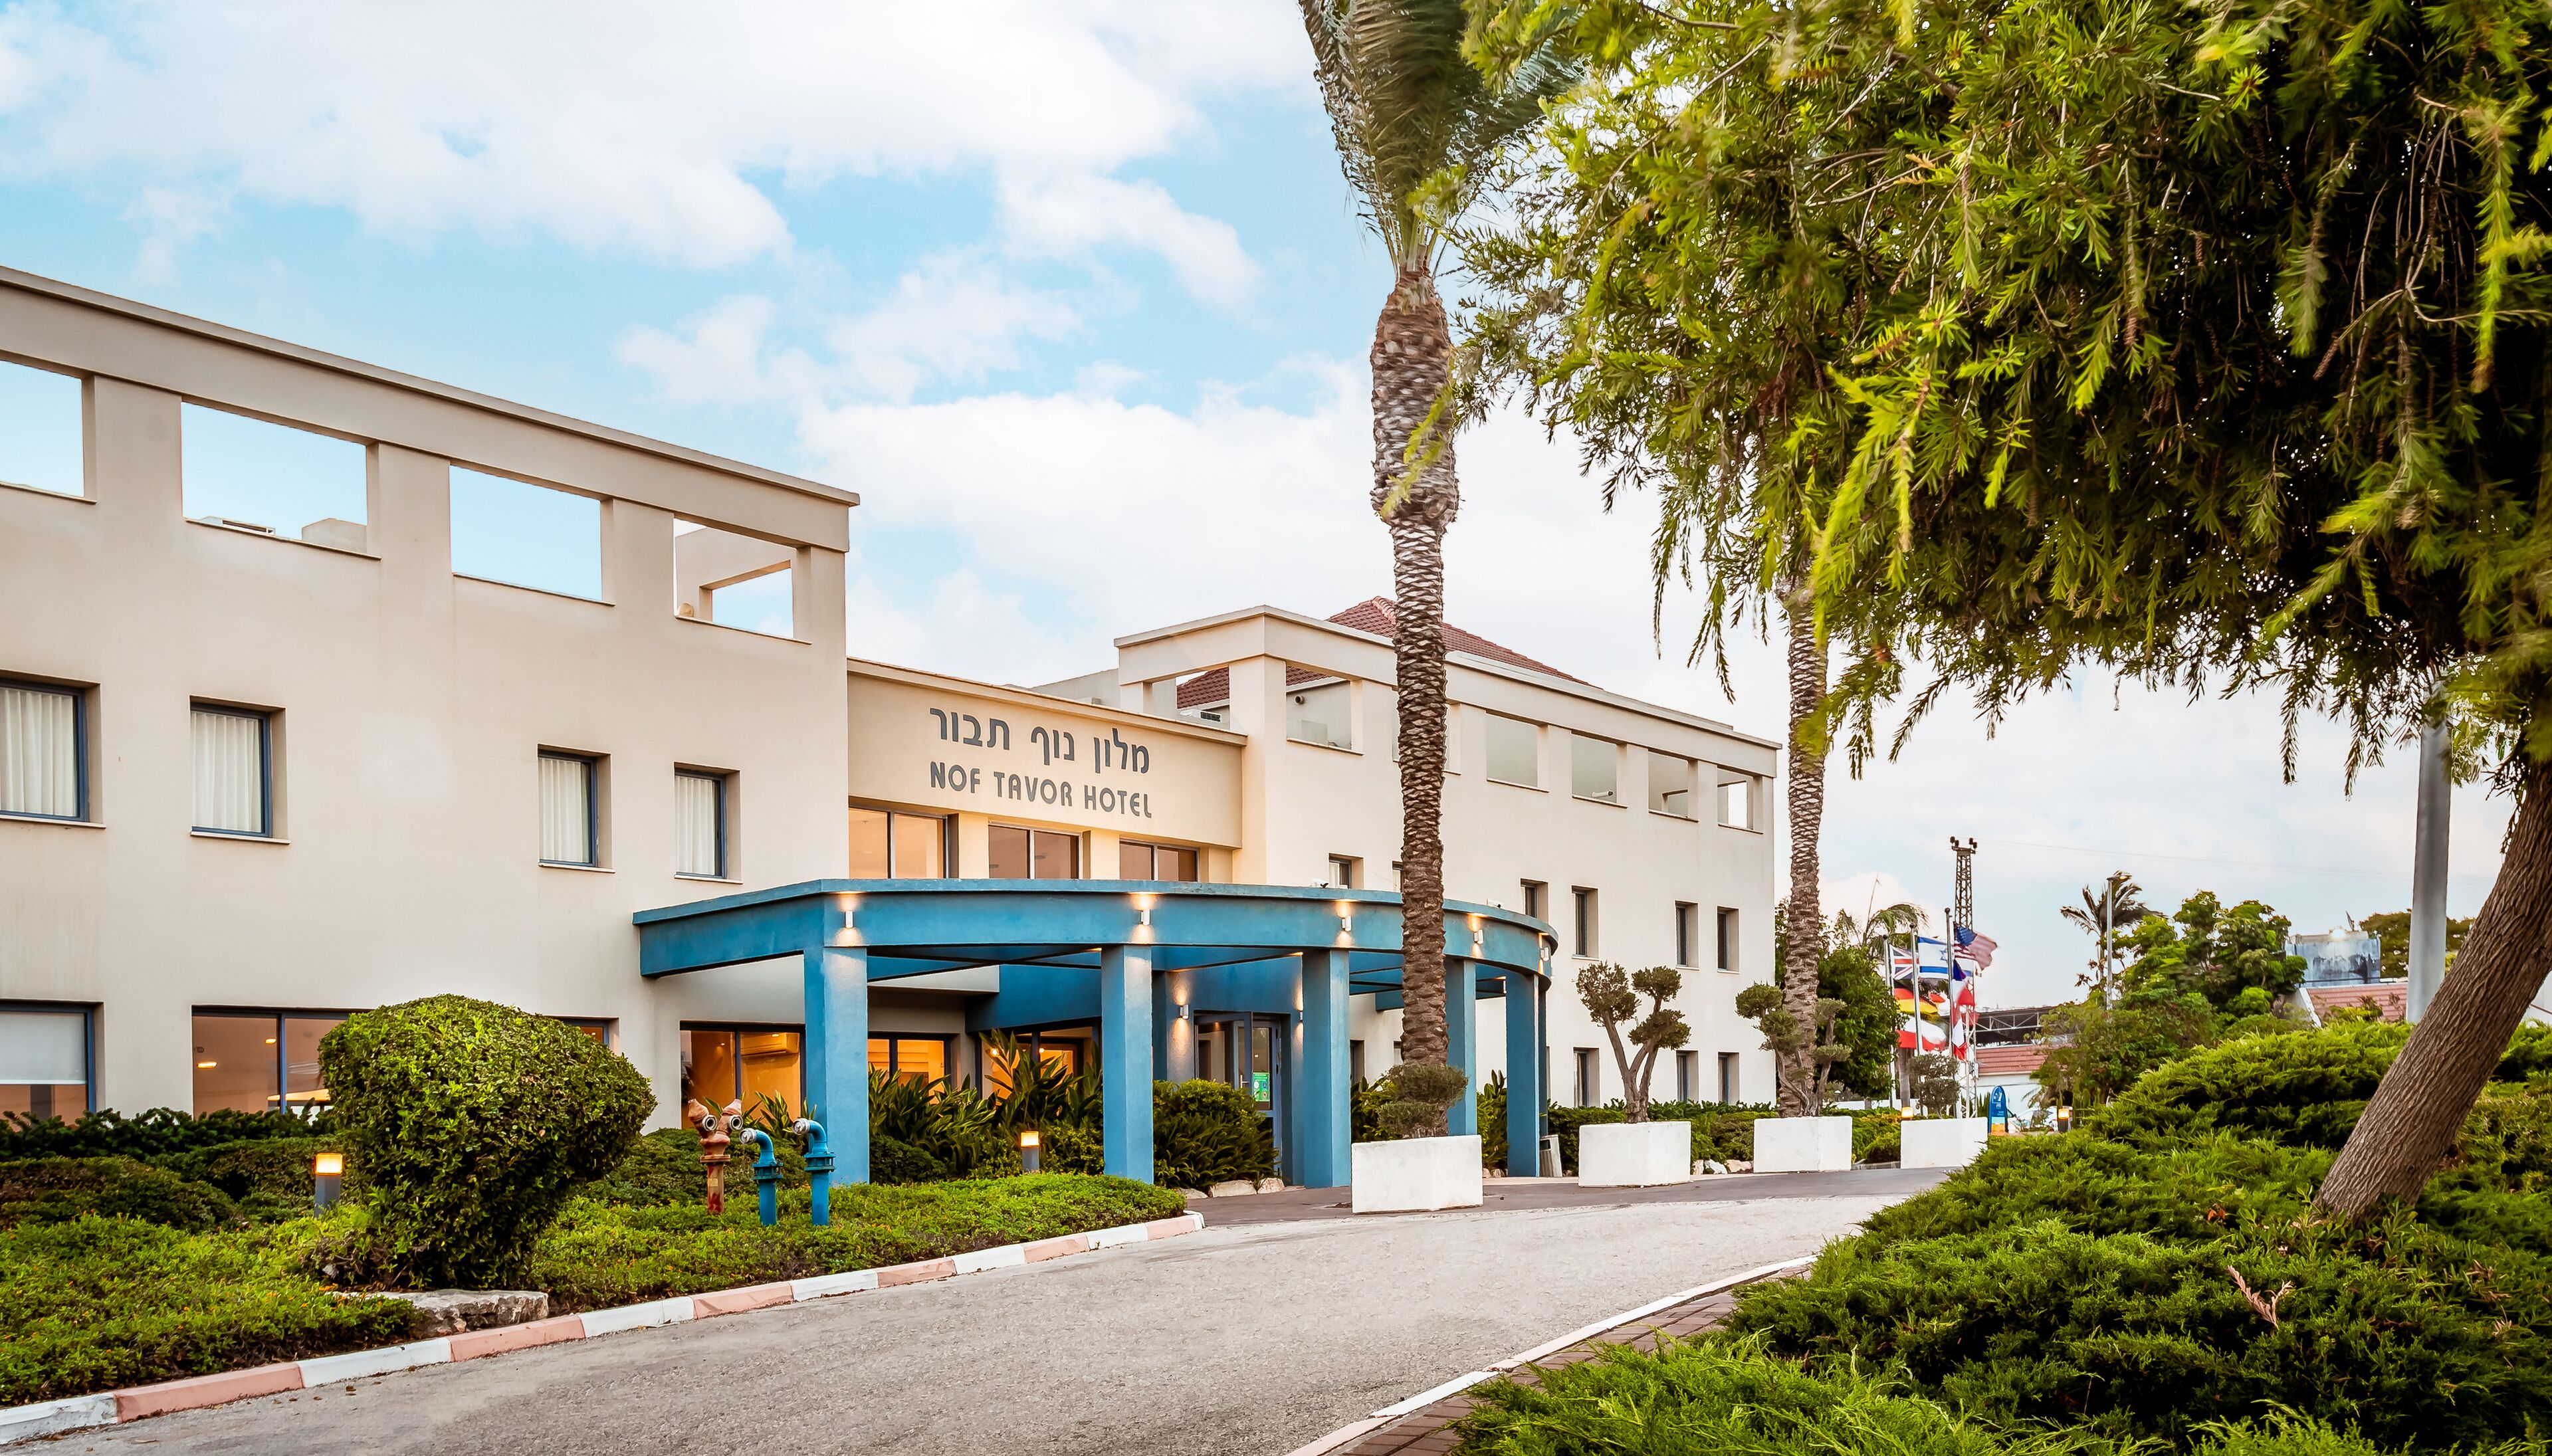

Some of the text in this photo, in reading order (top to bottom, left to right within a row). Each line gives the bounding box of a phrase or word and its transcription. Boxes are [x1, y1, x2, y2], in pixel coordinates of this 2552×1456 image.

[929, 707, 1150, 774] מלון נוף תבור
[930, 761, 1152, 819] NOF TAVOR HOTEL
